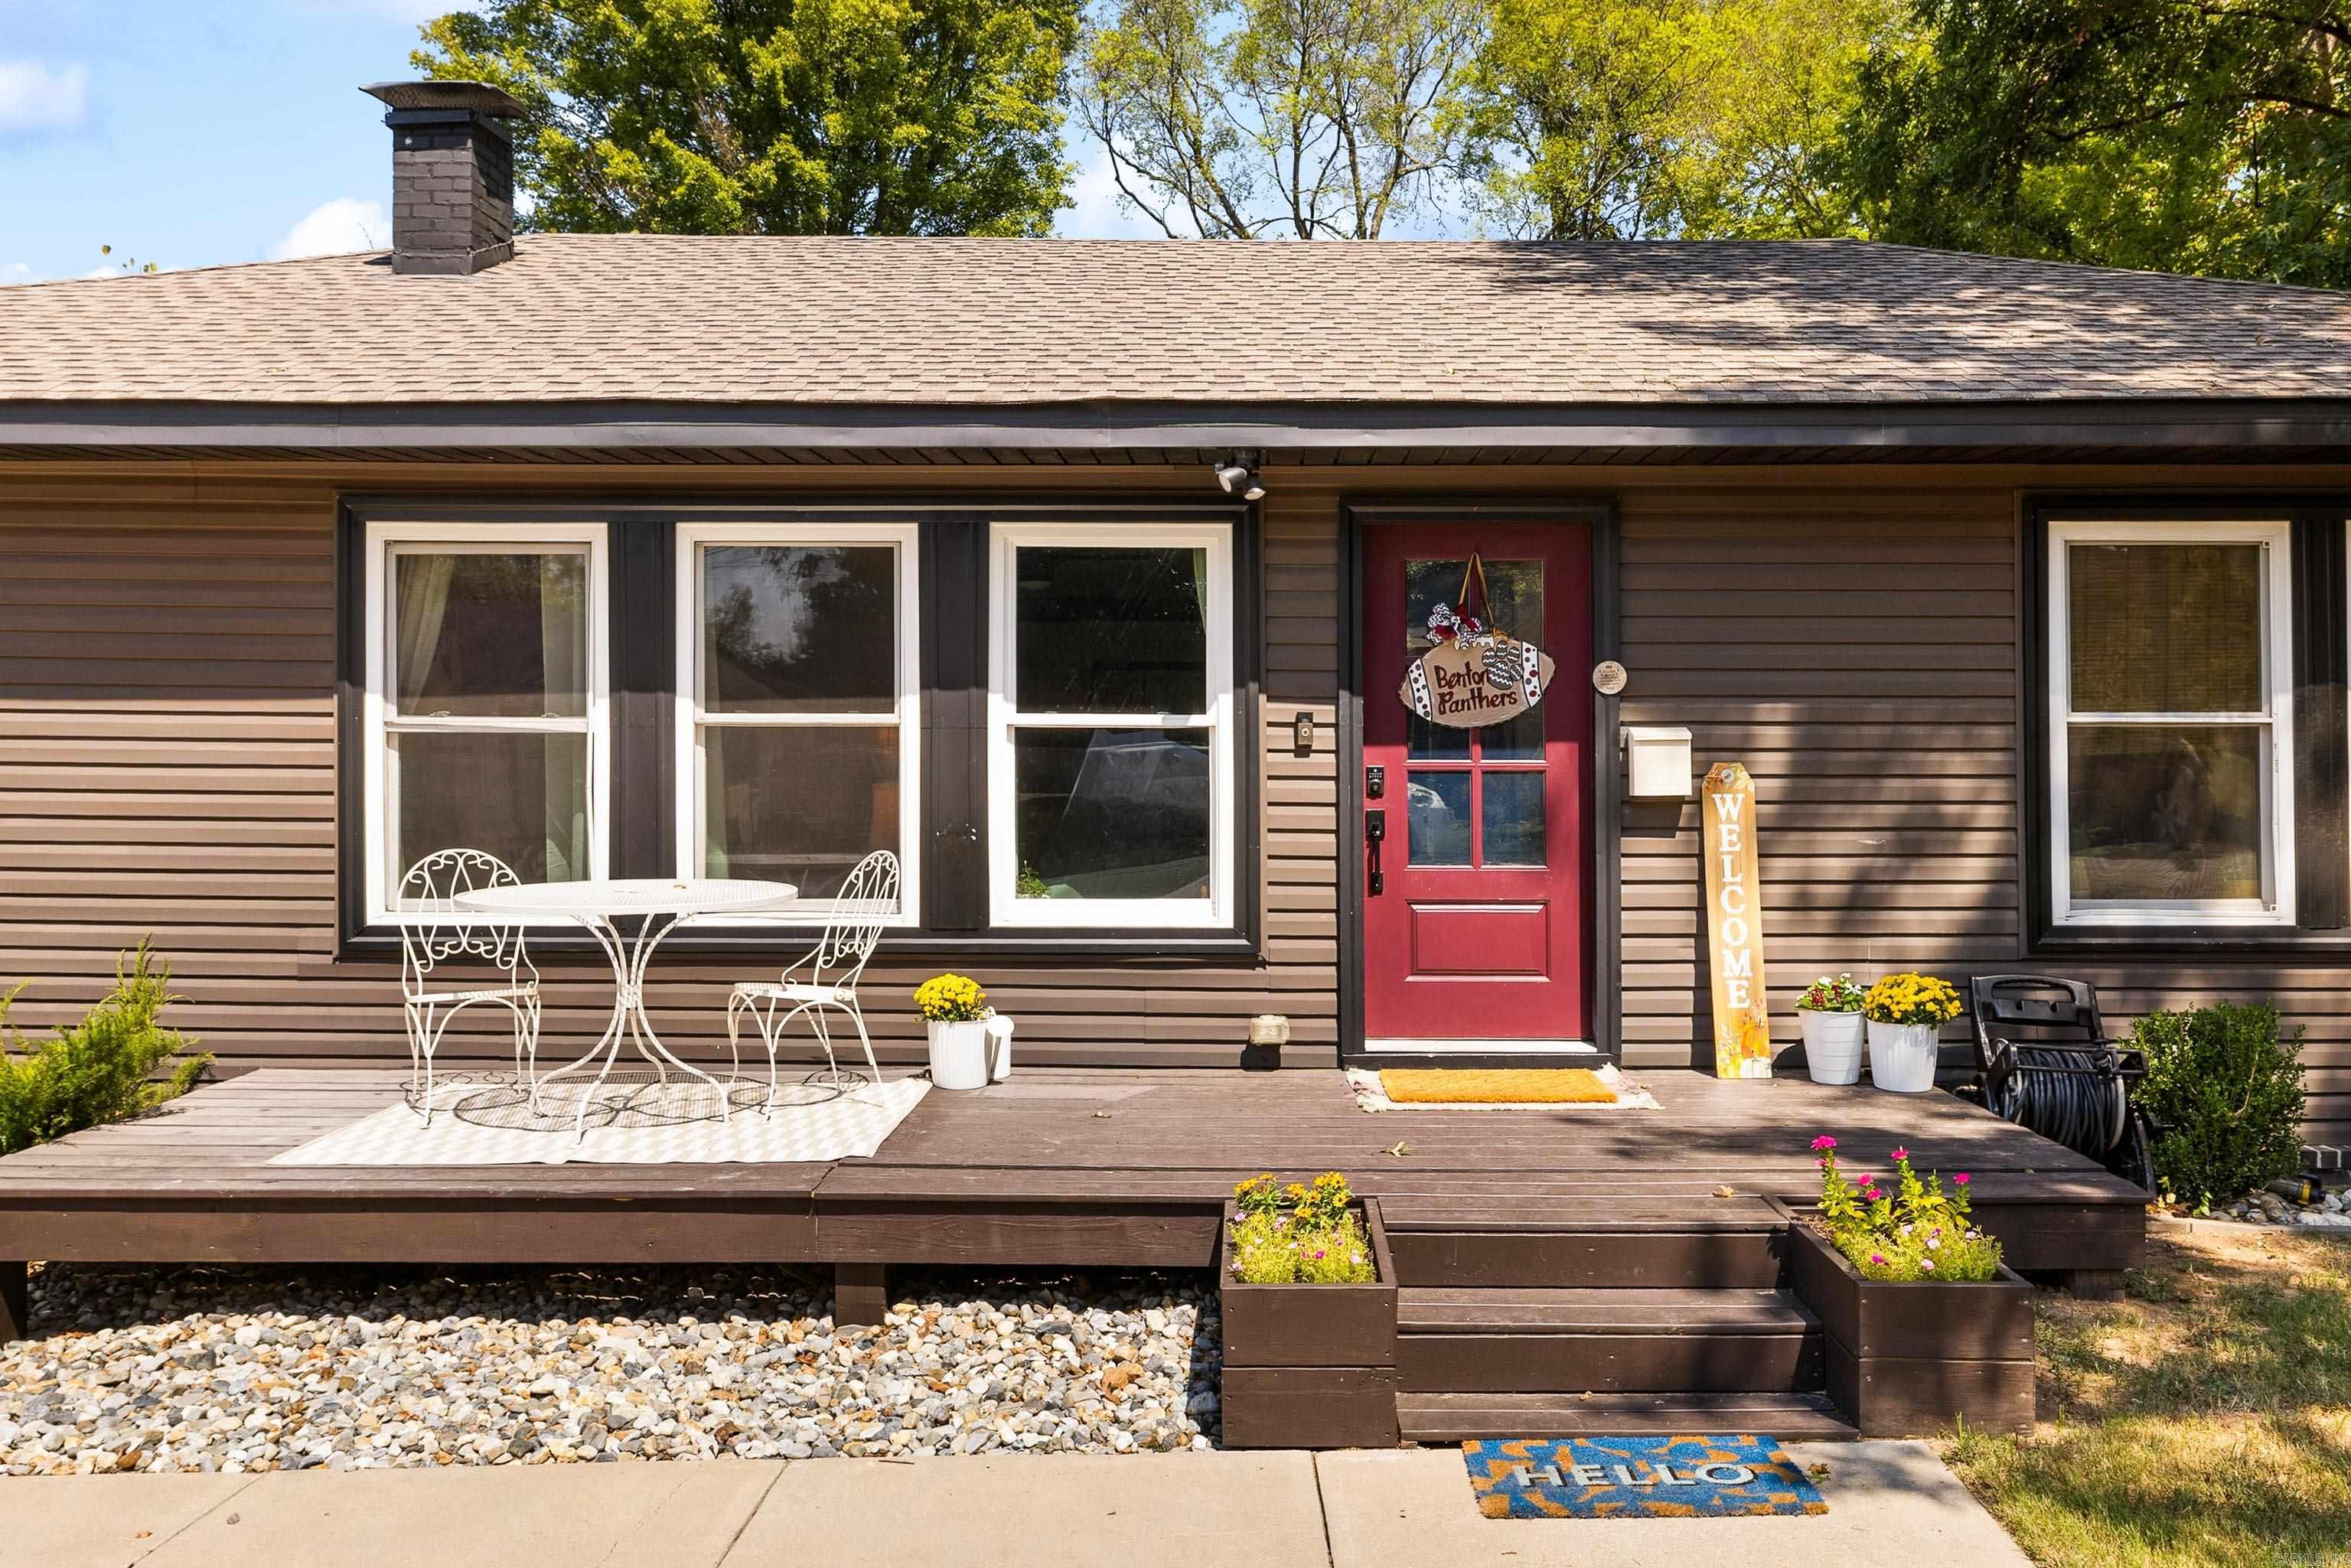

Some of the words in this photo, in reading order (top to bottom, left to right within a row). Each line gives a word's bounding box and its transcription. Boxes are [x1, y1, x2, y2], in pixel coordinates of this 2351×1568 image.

[1434, 661, 1488, 689] Benton
[1437, 687, 1518, 715] Panthers
[1712, 793, 1753, 1009] WELCOME
[1512, 1463, 1758, 1487] HELLO
